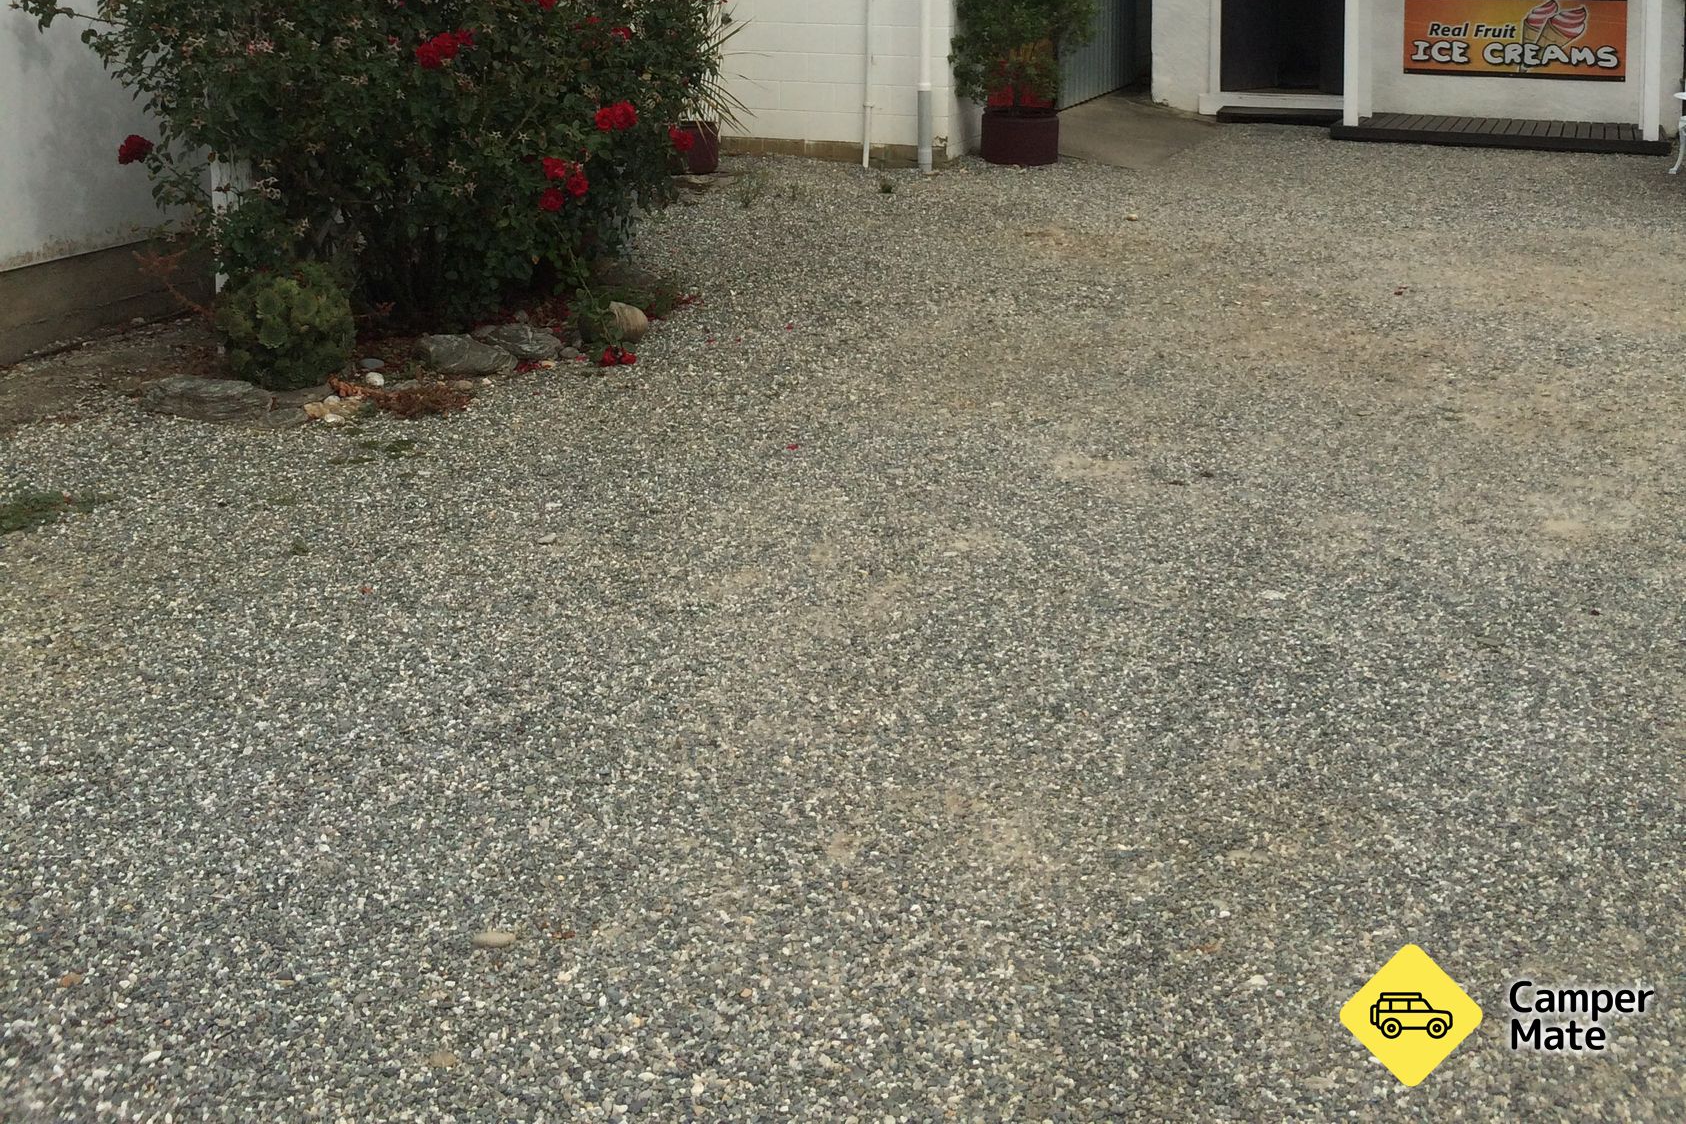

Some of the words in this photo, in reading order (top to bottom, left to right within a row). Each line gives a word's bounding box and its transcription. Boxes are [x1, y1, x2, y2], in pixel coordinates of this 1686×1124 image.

[1429, 22, 1469, 37] Real
[1474, 24, 1516, 39] Fruit
[1410, 40, 1470, 64] ICE
[1482, 42, 1619, 69] CREAMS
